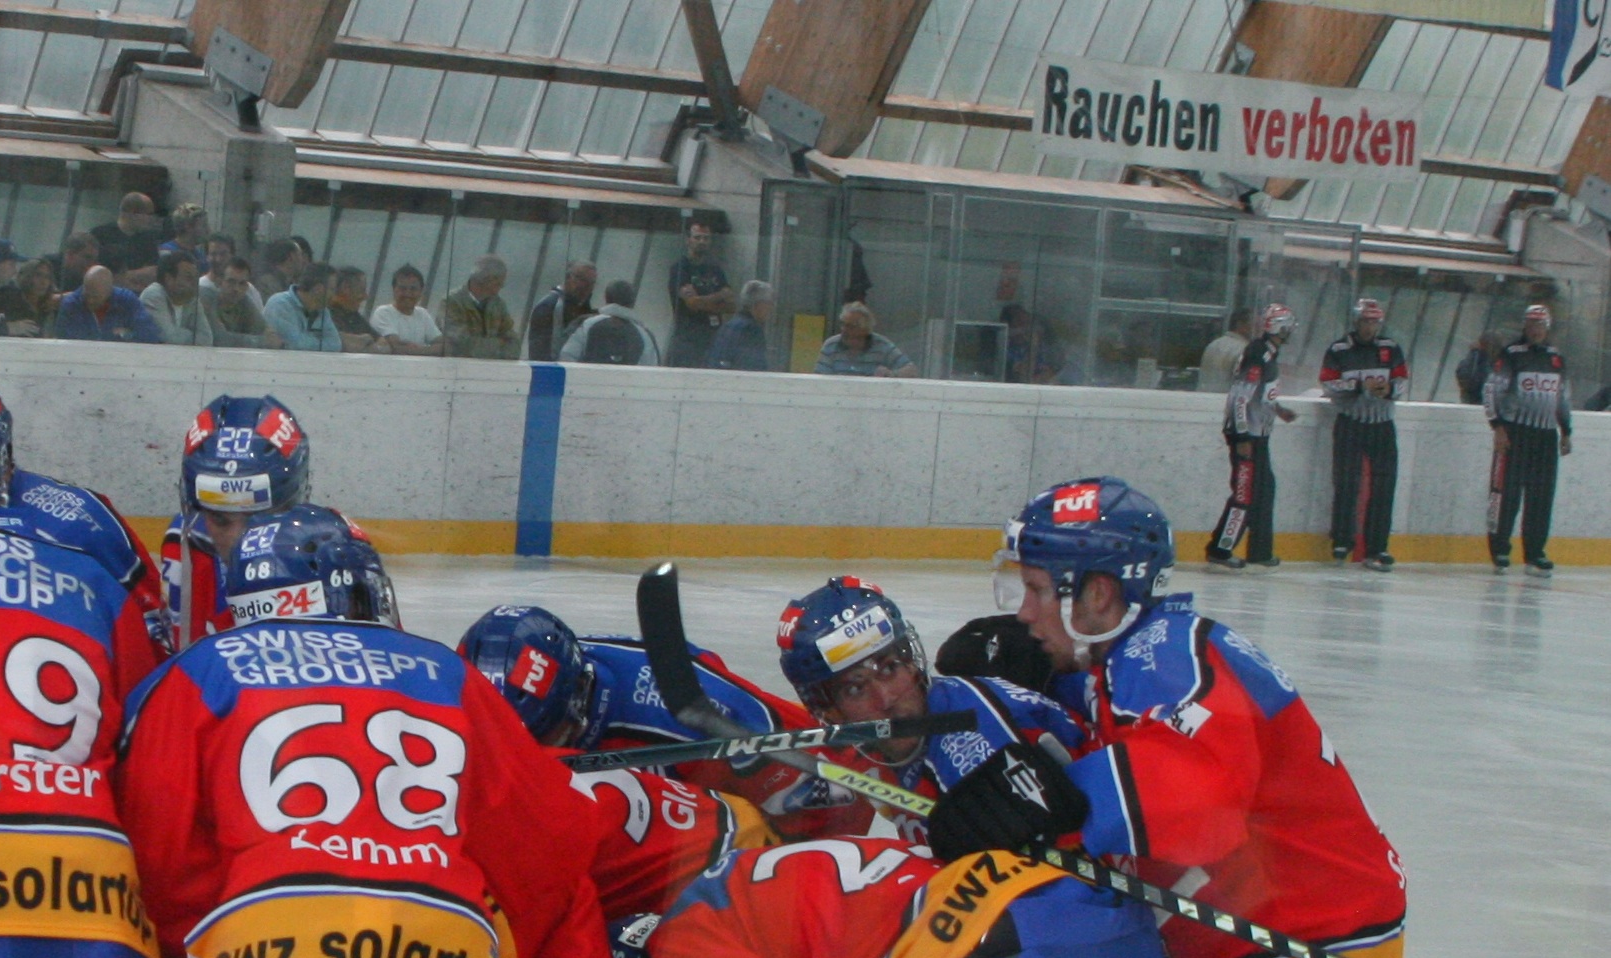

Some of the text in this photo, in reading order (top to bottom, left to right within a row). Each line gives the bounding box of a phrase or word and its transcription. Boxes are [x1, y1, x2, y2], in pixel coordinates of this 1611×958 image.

[1041, 65, 1418, 168] Rauchen verboten
[216, 427, 253, 453] 20
[270, 413, 295, 448] ruf
[224, 460, 238, 476] 9
[220, 479, 254, 493] ewz
[21, 491, 79, 522] GROUP
[1053, 489, 1098, 514] ruf
[244, 562, 271, 580] 68
[329, 568, 354, 587] 68
[1122, 562, 1148, 580] 15
[230, 600, 274, 620] Radio
[275, 587, 313, 617] 24
[844, 614, 876, 640] ewz
[214, 630, 364, 657] SWISS
[227, 646, 440, 681] CONCEPT
[232, 662, 397, 686] GROUP
[521, 650, 552, 693] ruf
[728, 728, 826, 758] CCM
[239, 704, 467, 836] 68
[290, 828, 450, 868] Lemm
